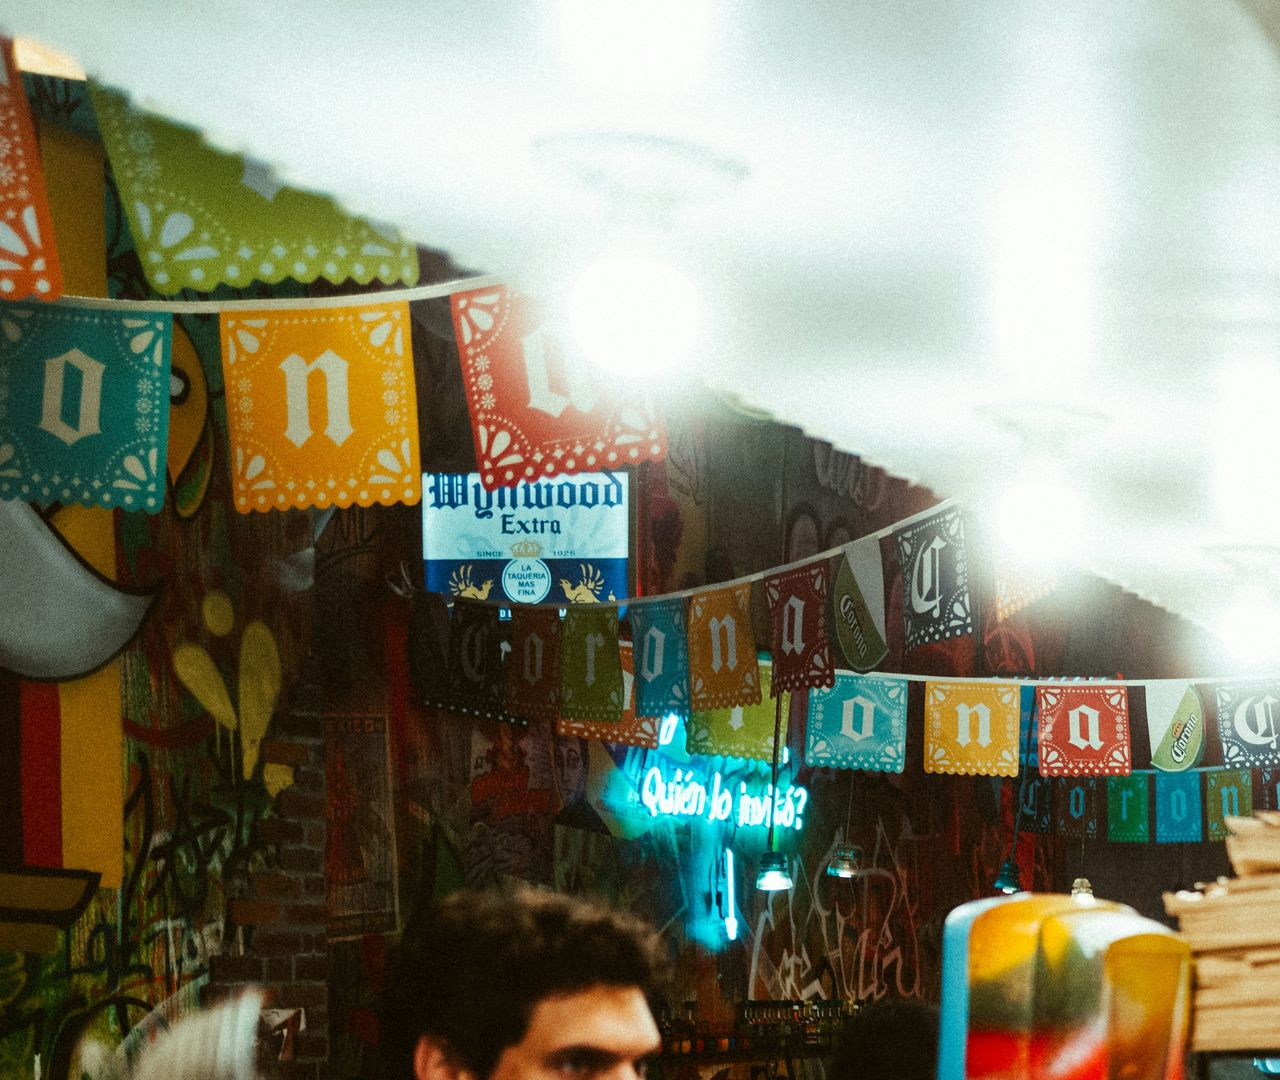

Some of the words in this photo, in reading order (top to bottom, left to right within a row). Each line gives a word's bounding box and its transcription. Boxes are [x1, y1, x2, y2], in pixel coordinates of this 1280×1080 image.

[428, 472, 624, 520] Wynwood
[500, 513, 562, 535] Extra
[476, 550, 504, 558] SINCE
[839, 593, 869, 659] Corona
[1169, 712, 1199, 764] Corona
[708, 771, 733, 821] lo
